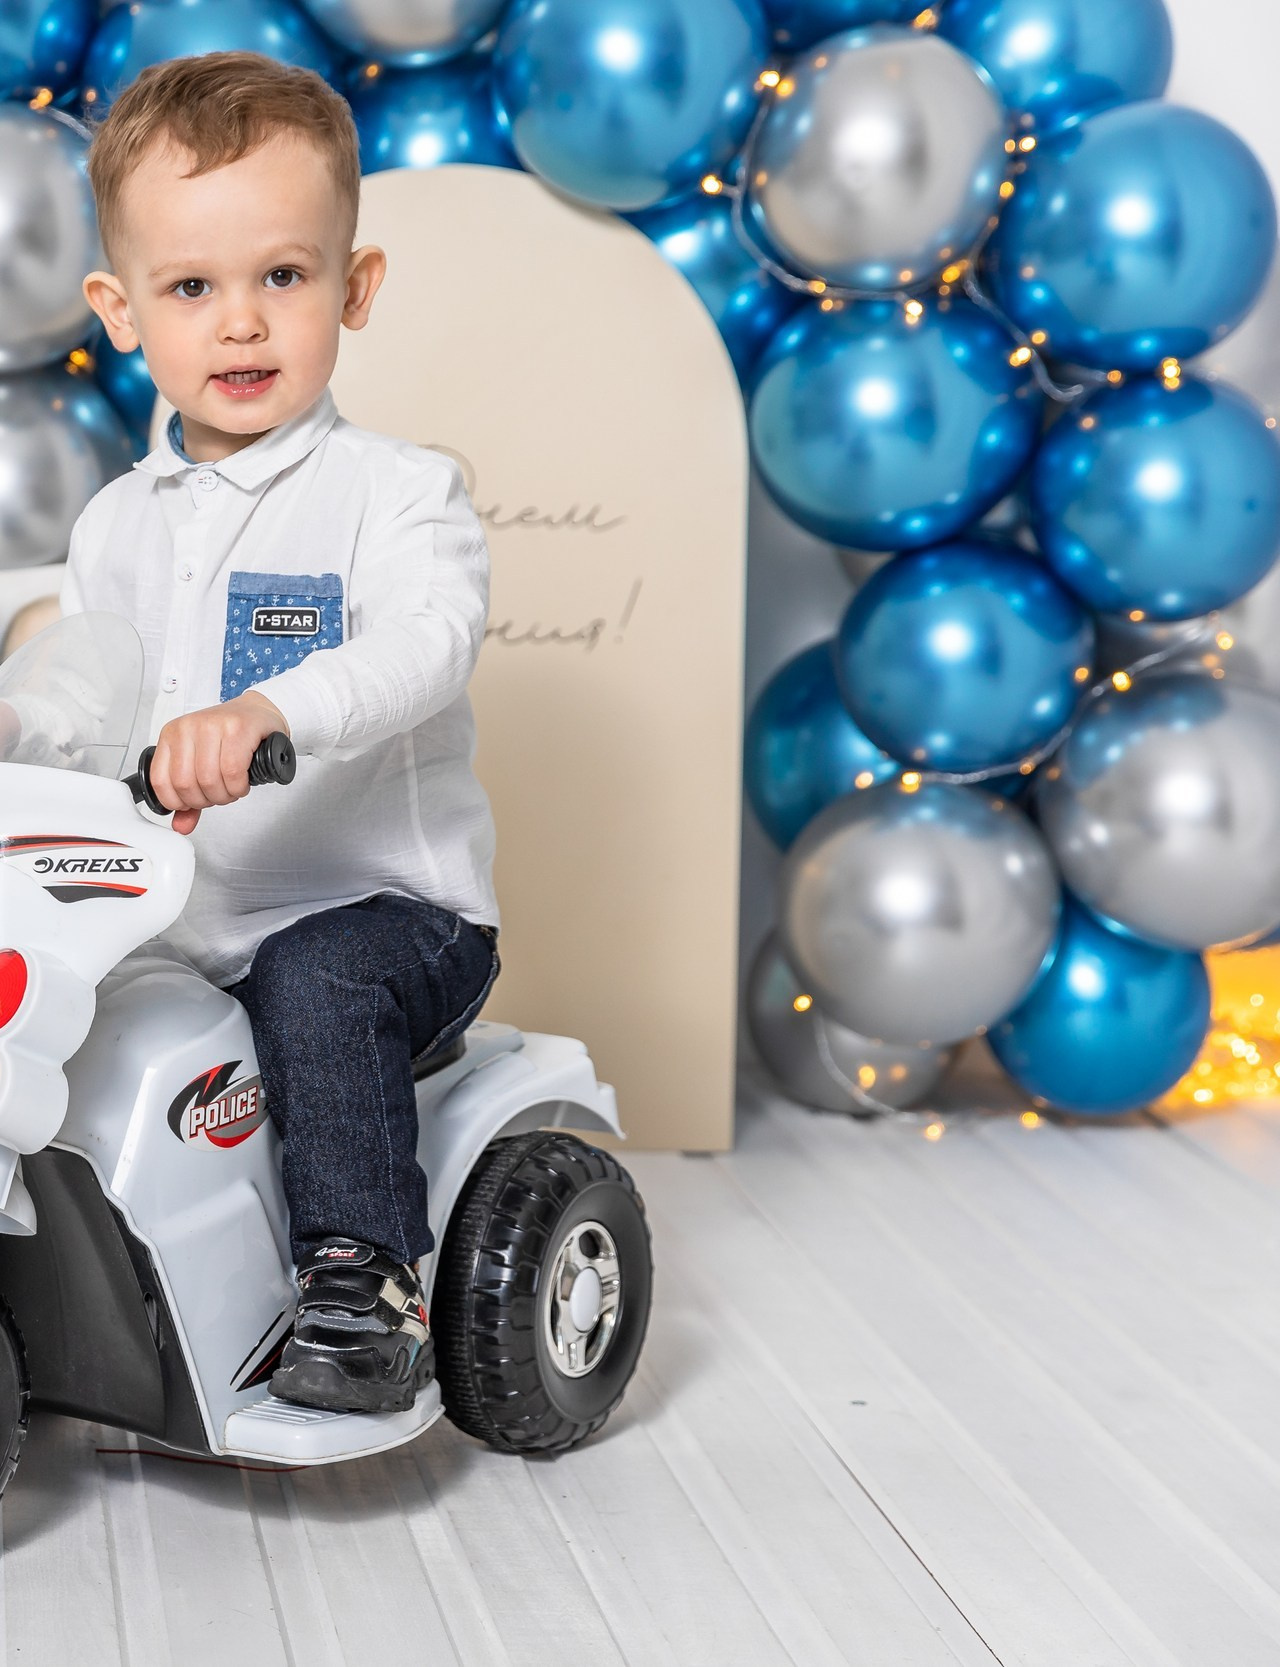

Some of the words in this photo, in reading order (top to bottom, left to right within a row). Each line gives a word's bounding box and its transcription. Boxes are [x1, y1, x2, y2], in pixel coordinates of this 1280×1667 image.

[257, 614, 314, 627] T-STAR
[52, 858, 144, 873] KREISS
[188, 1085, 259, 1139] POLICE
